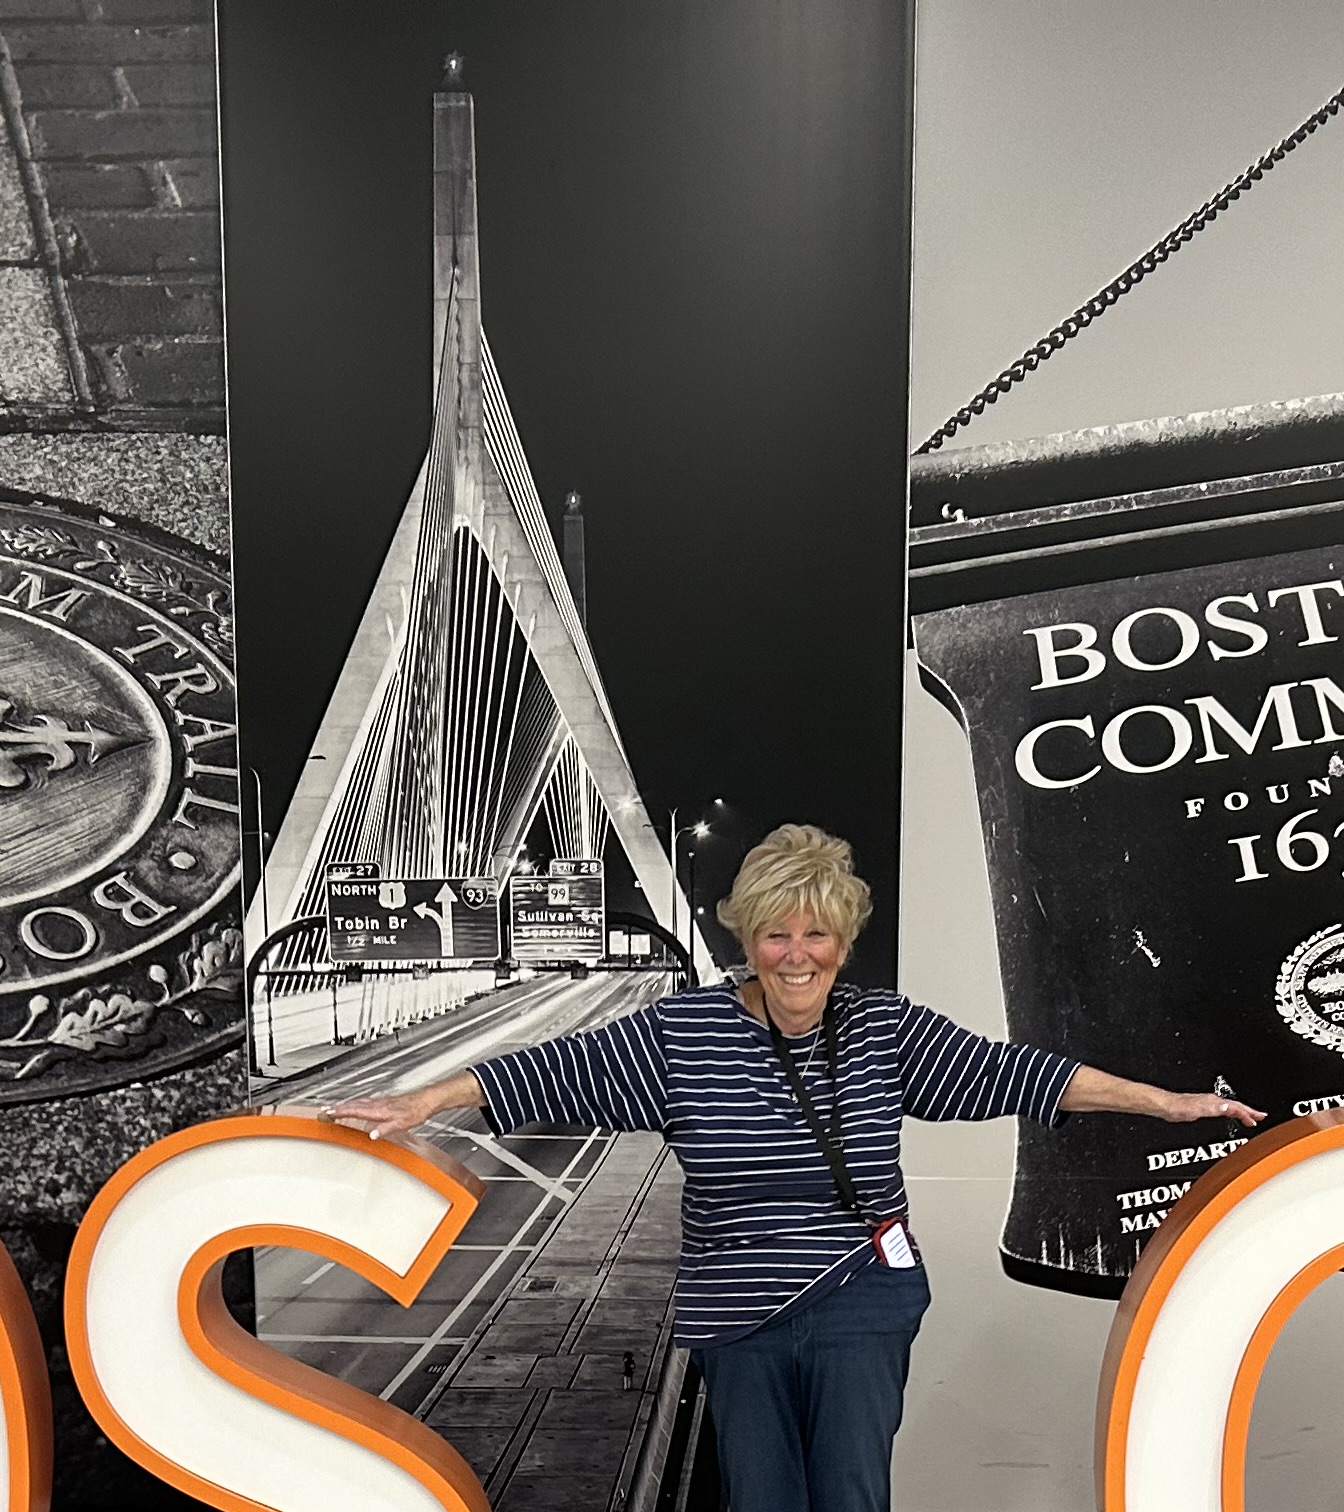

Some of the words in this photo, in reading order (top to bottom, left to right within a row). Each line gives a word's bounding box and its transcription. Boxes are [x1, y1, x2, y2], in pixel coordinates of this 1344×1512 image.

[113, 624, 240, 832] TRAIL
[355, 865, 374, 876] 27
[580, 862, 598, 874] 28
[331, 883, 377, 897] NORTH
[466, 888, 485, 903] 93
[550, 888, 567, 900] 99
[517, 910, 574, 922] Sullivan
[333, 916, 380, 931] Tobin
[388, 916, 408, 930] Br
[373, 935, 397, 945] MILE
[1147, 1138, 1249, 1171] DEPART
[1116, 1181, 1192, 1210] THOM
